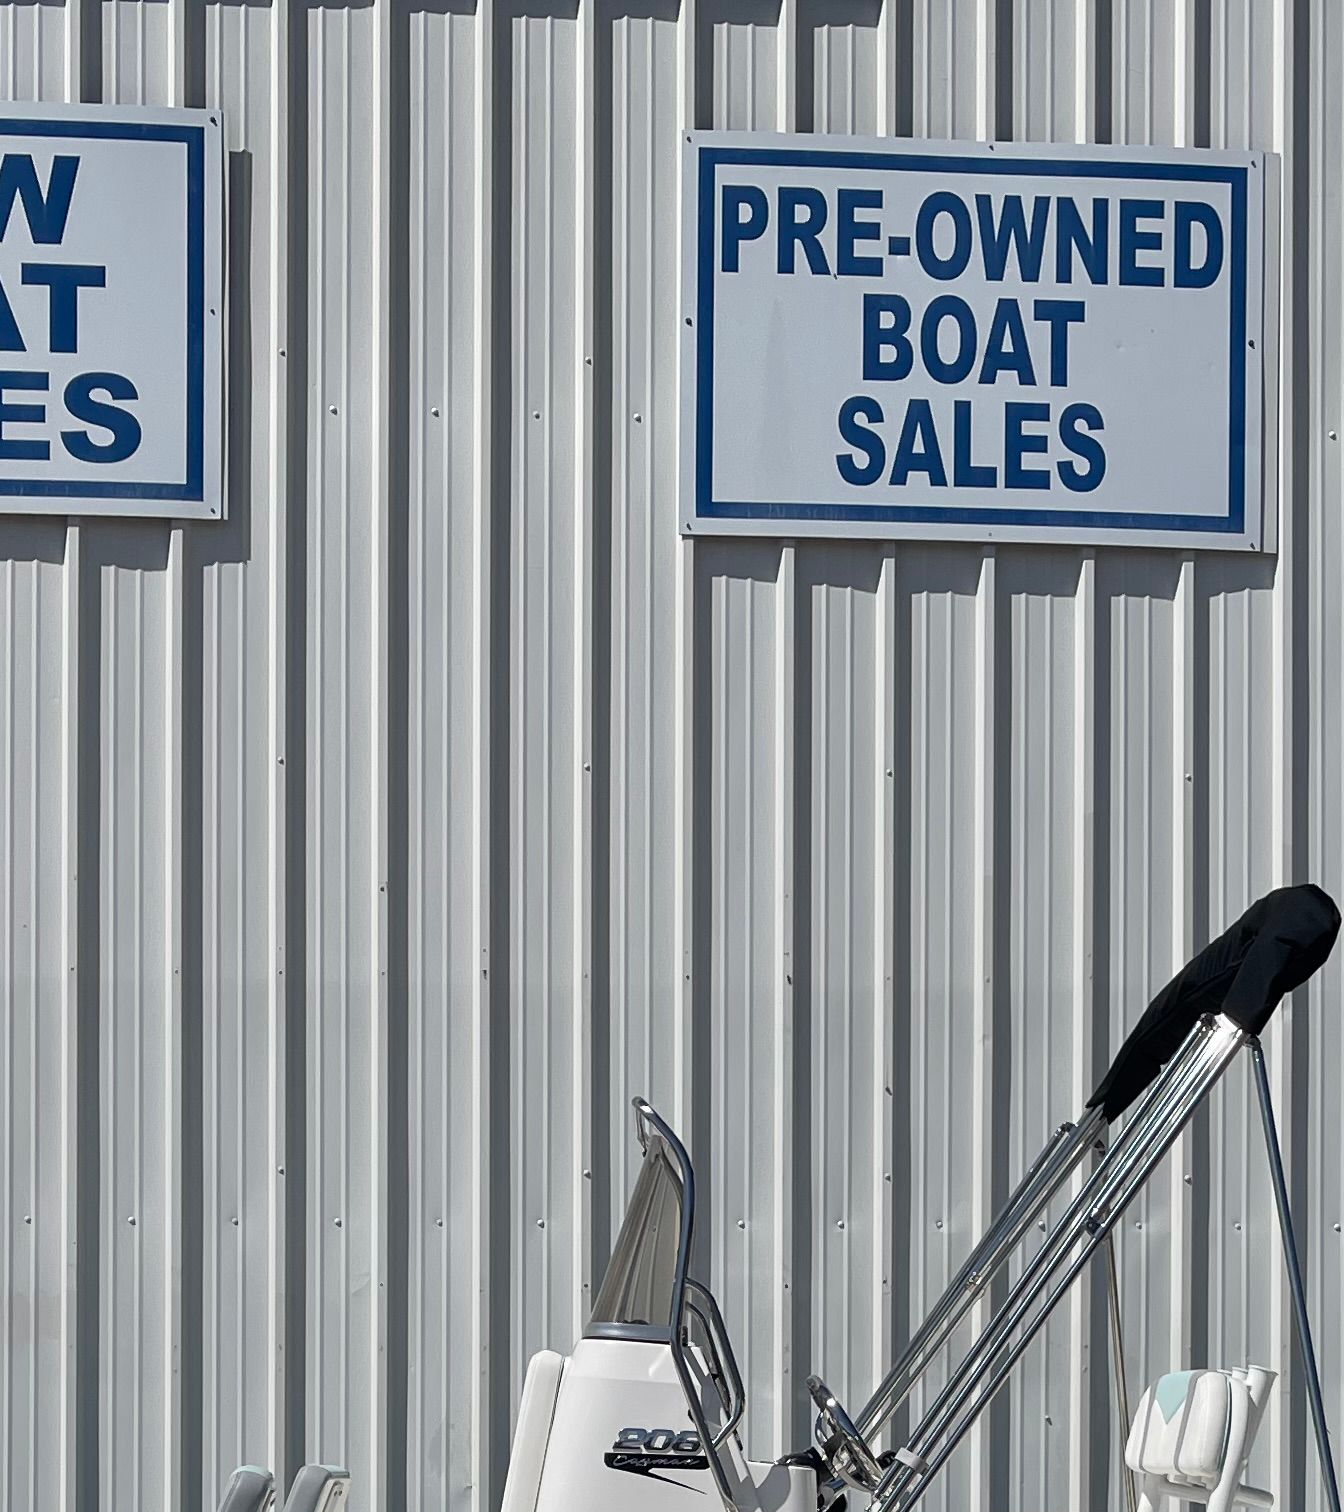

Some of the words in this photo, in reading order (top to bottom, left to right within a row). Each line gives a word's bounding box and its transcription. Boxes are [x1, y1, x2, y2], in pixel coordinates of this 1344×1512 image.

[720, 184, 1225, 289] PRE-OWNED
[862, 292, 1086, 388] BOAT
[835, 395, 1107, 493] SALES
